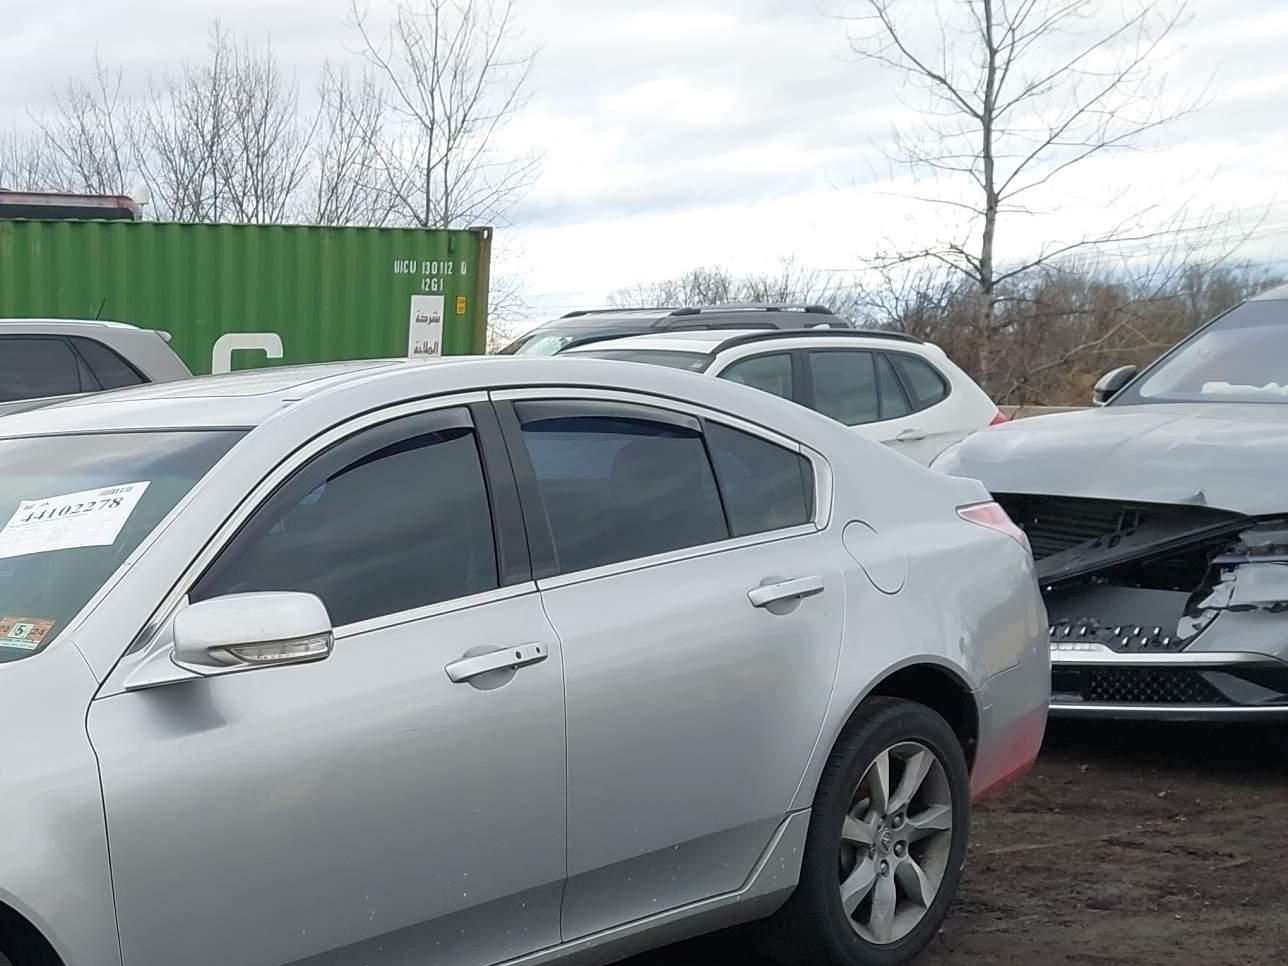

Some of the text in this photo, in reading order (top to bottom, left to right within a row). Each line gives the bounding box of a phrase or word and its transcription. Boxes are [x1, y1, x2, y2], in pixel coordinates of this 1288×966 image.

[421, 261, 453, 275] 130112
[20, 496, 125, 523] 44102278
[14, 624, 27, 637] 5
